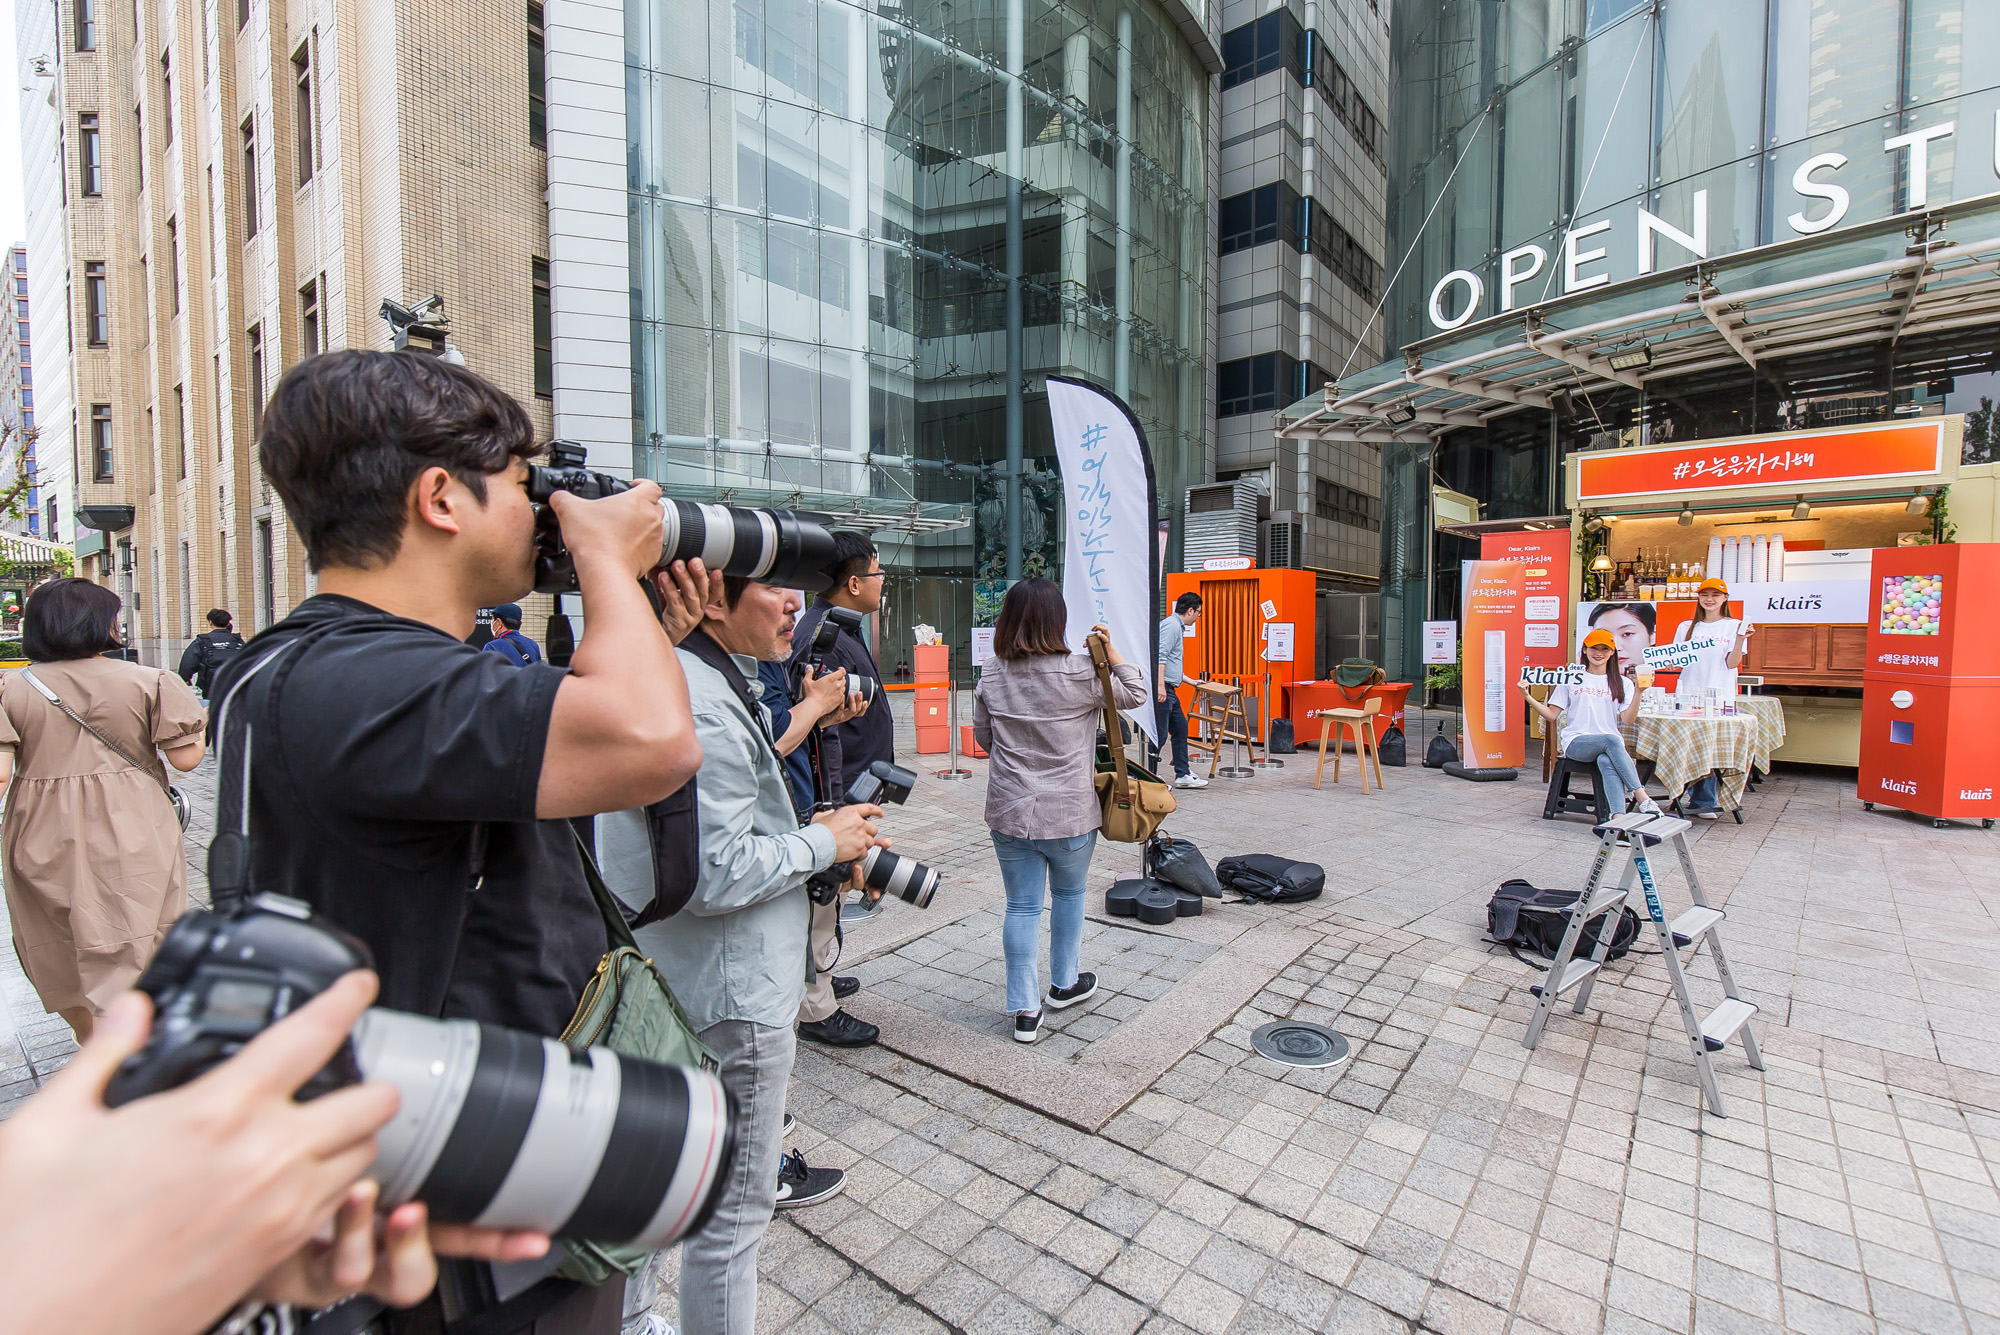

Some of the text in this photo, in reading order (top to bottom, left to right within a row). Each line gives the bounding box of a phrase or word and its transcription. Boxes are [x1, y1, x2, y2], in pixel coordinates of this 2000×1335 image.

[1429, 109, 2000, 330] OPEN ST
[1672, 451, 1815, 480] #오늘은차지해
[1472, 588, 1517, 598] #오늘은차지해
[1768, 596, 1822, 610] klairs
[1643, 643, 1688, 659] Simple
[1691, 638, 1715, 650] but
[1878, 653, 1939, 667] #행운을차지해
[1523, 668, 1583, 685] klairs
[1881, 778, 1917, 795] klairs
[1960, 789, 1992, 800] klairs
[1643, 874, 1662, 917] 세계일보
